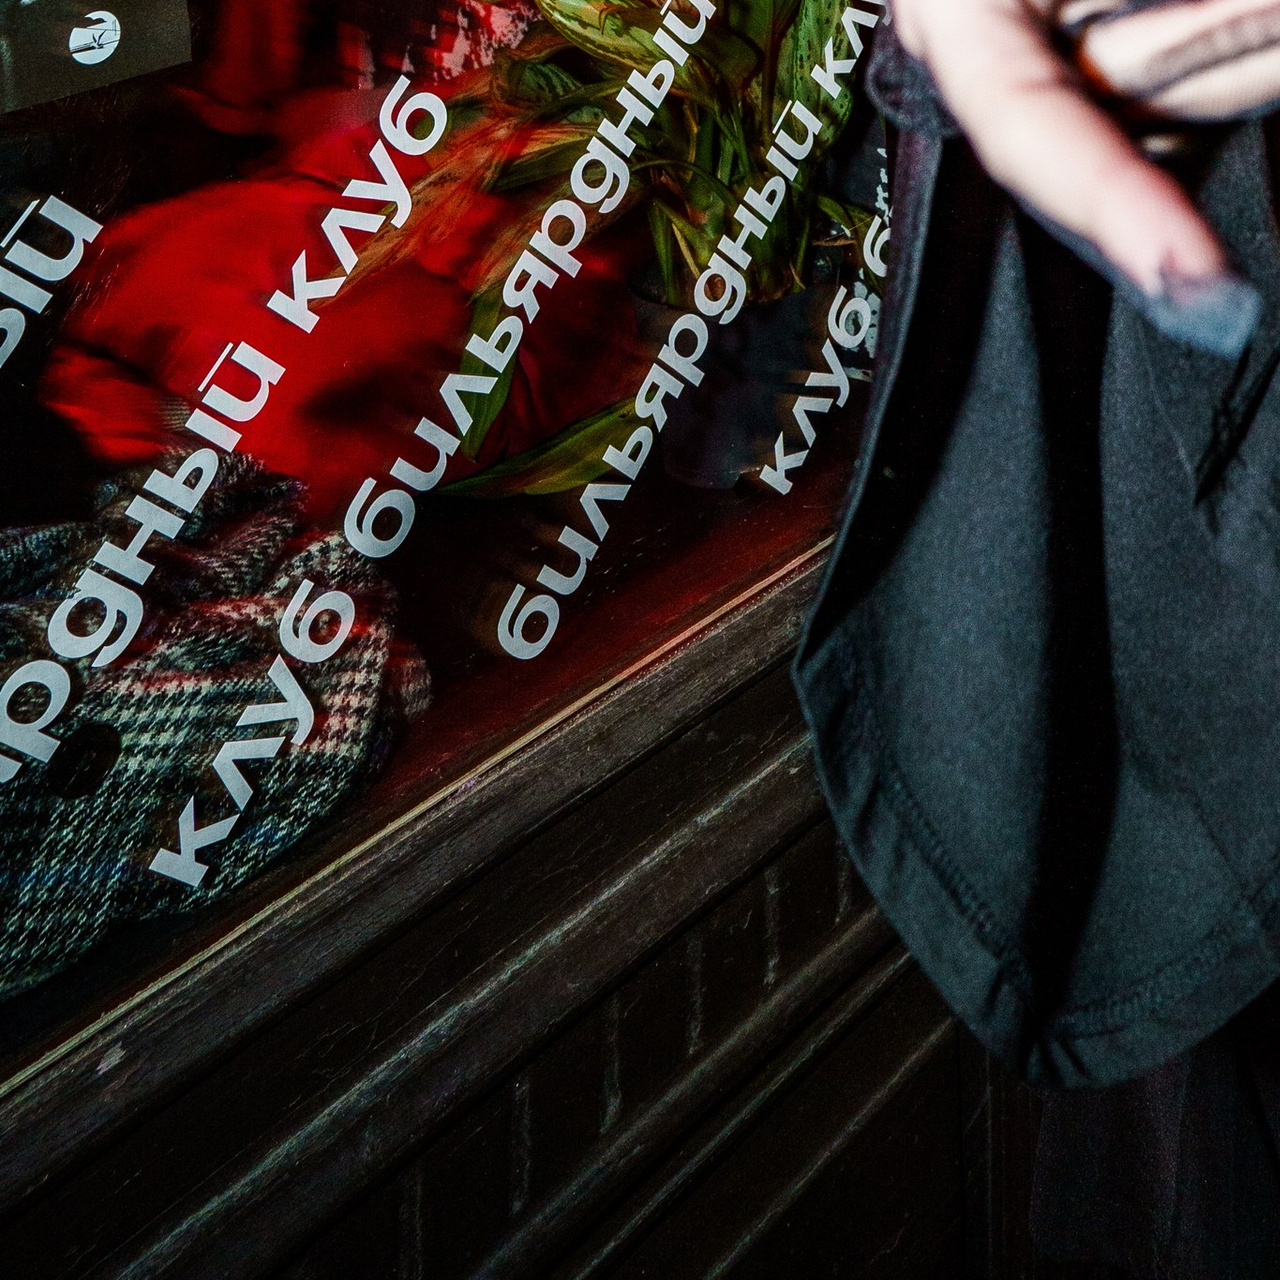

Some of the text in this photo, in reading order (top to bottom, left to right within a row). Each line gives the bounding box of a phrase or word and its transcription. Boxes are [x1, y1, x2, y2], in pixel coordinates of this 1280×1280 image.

[267, 74, 449, 335] клуб
[759, 285, 872, 495] клуб
[148, 579, 357, 889] клуб
